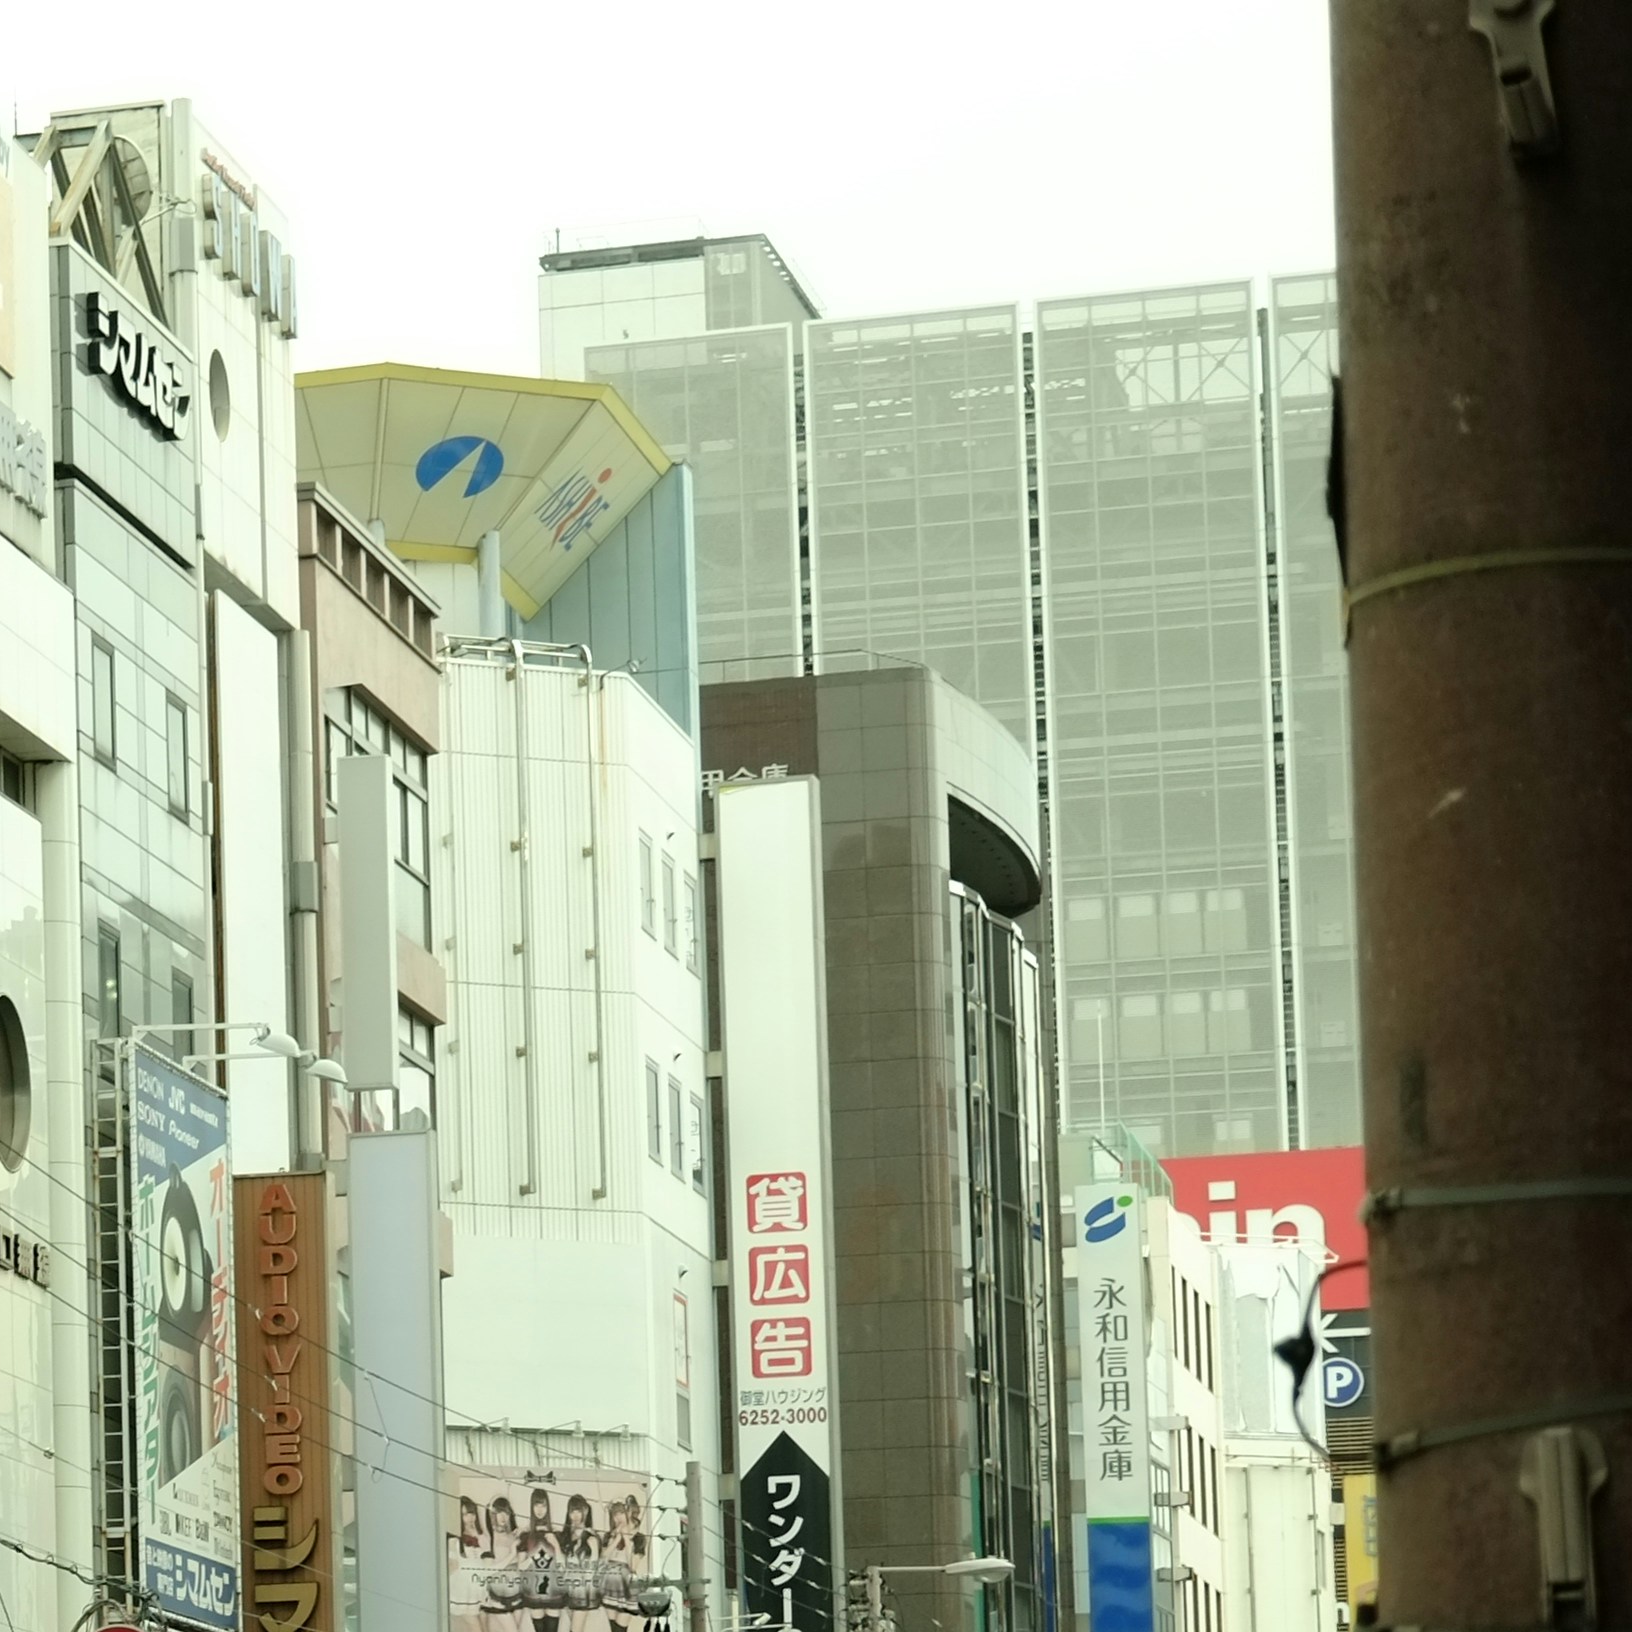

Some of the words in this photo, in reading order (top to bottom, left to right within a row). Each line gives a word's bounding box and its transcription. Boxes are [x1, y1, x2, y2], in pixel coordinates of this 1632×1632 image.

[138, 1101, 165, 1131] SONY
[259, 1183, 298, 1336] AUDIO
[746, 1174, 810, 1377] 貸広告
[262, 1342, 303, 1497] VIDEO
[739, 1406, 827, 1427] 6252-3000
[1094, 1276, 1134, 1482] 永和信用金庫
[176, 1554, 235, 1617] シマムセン
